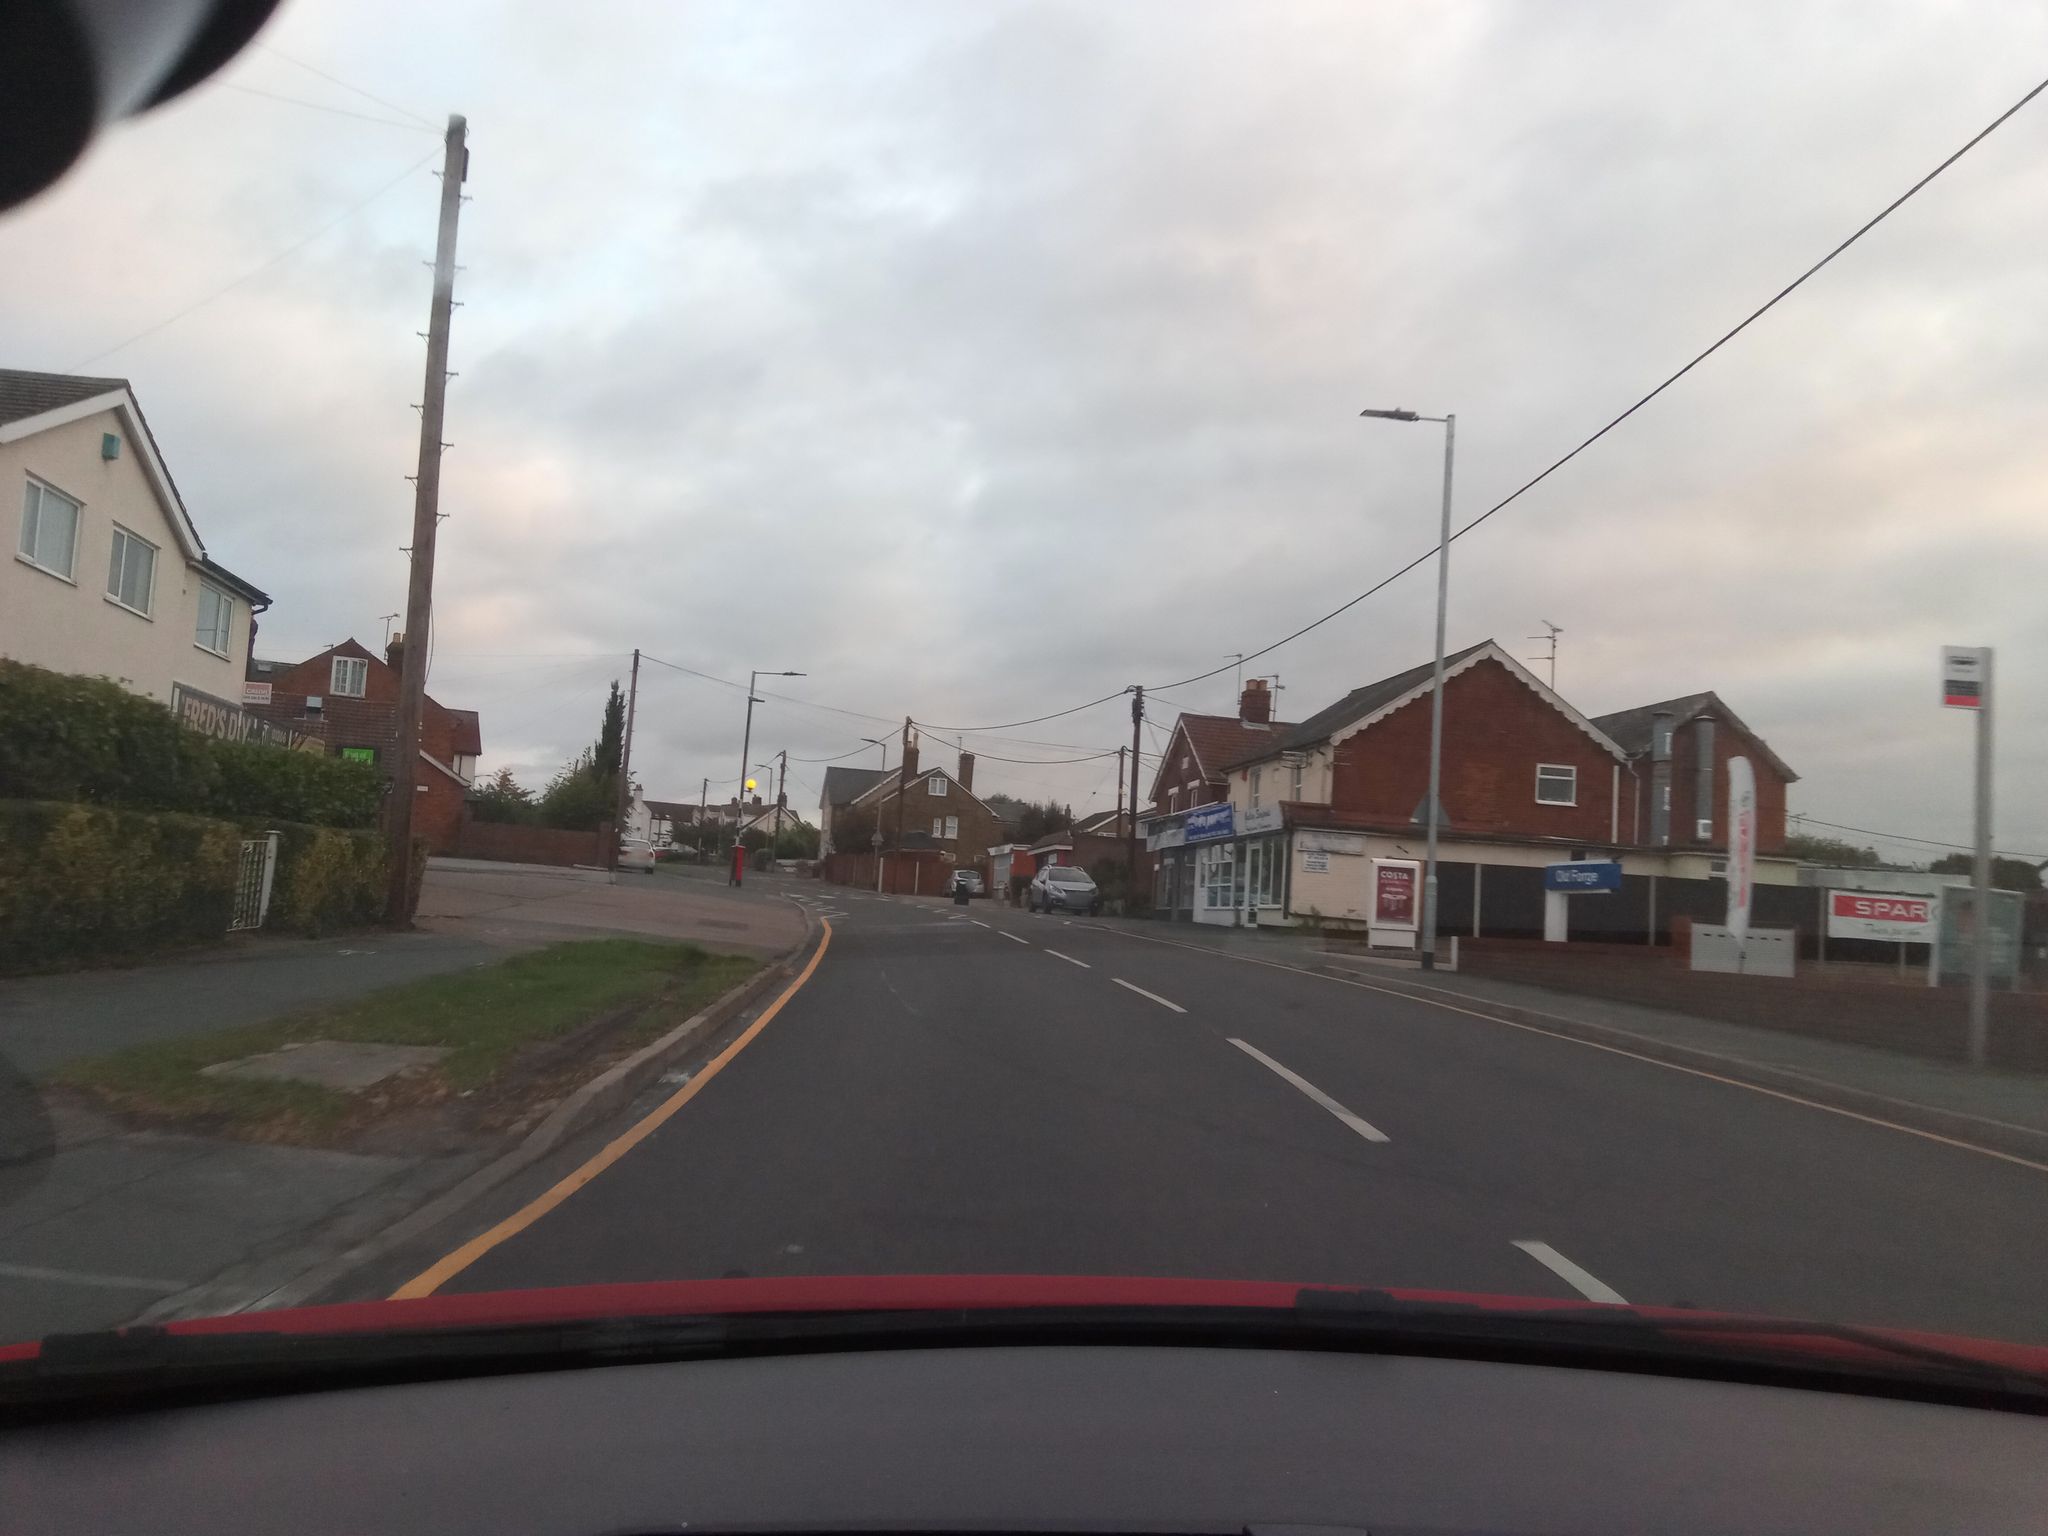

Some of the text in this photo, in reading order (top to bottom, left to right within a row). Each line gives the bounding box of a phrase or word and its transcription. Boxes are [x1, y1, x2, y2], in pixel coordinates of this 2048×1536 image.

[183, 697, 252, 745] FRED'S DIY
[1380, 871, 1409, 880] COSTA
[1570, 869, 1599, 885] Forge
[1855, 900, 1928, 918] SPAR
